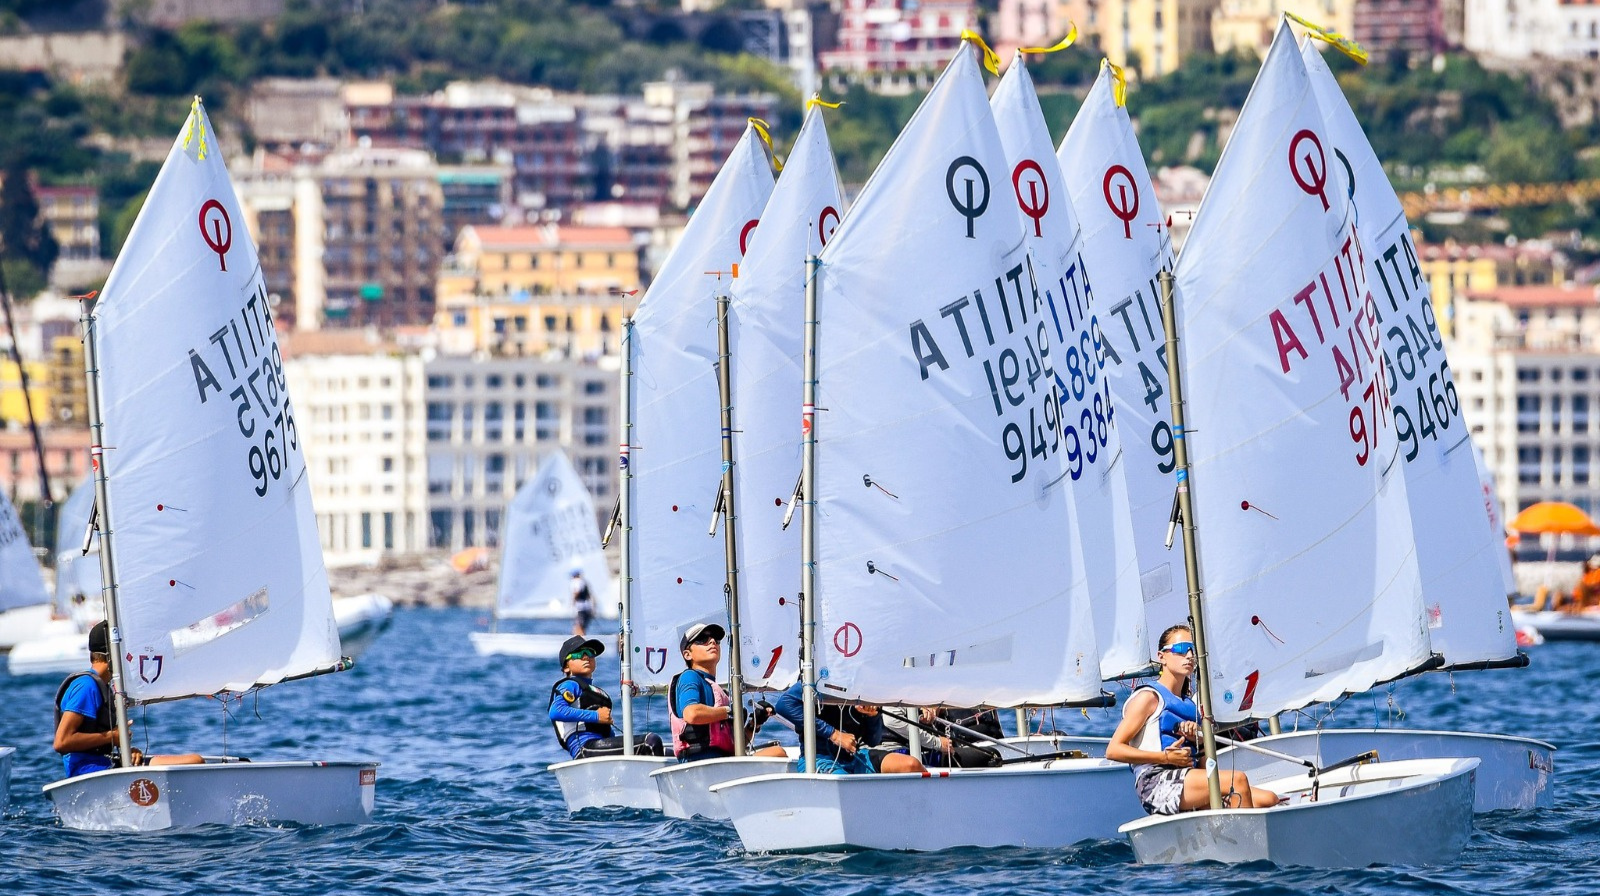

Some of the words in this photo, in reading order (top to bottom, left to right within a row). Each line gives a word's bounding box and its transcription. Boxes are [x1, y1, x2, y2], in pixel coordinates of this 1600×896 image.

[995, 253, 1042, 334] ITA
[1059, 252, 1094, 332] ITA
[1374, 233, 1423, 312] ITA
[241, 284, 273, 357] ITA
[248, 397, 297, 497] 9675
[1064, 376, 1115, 481] 9384
[1394, 360, 1458, 463] 9466
